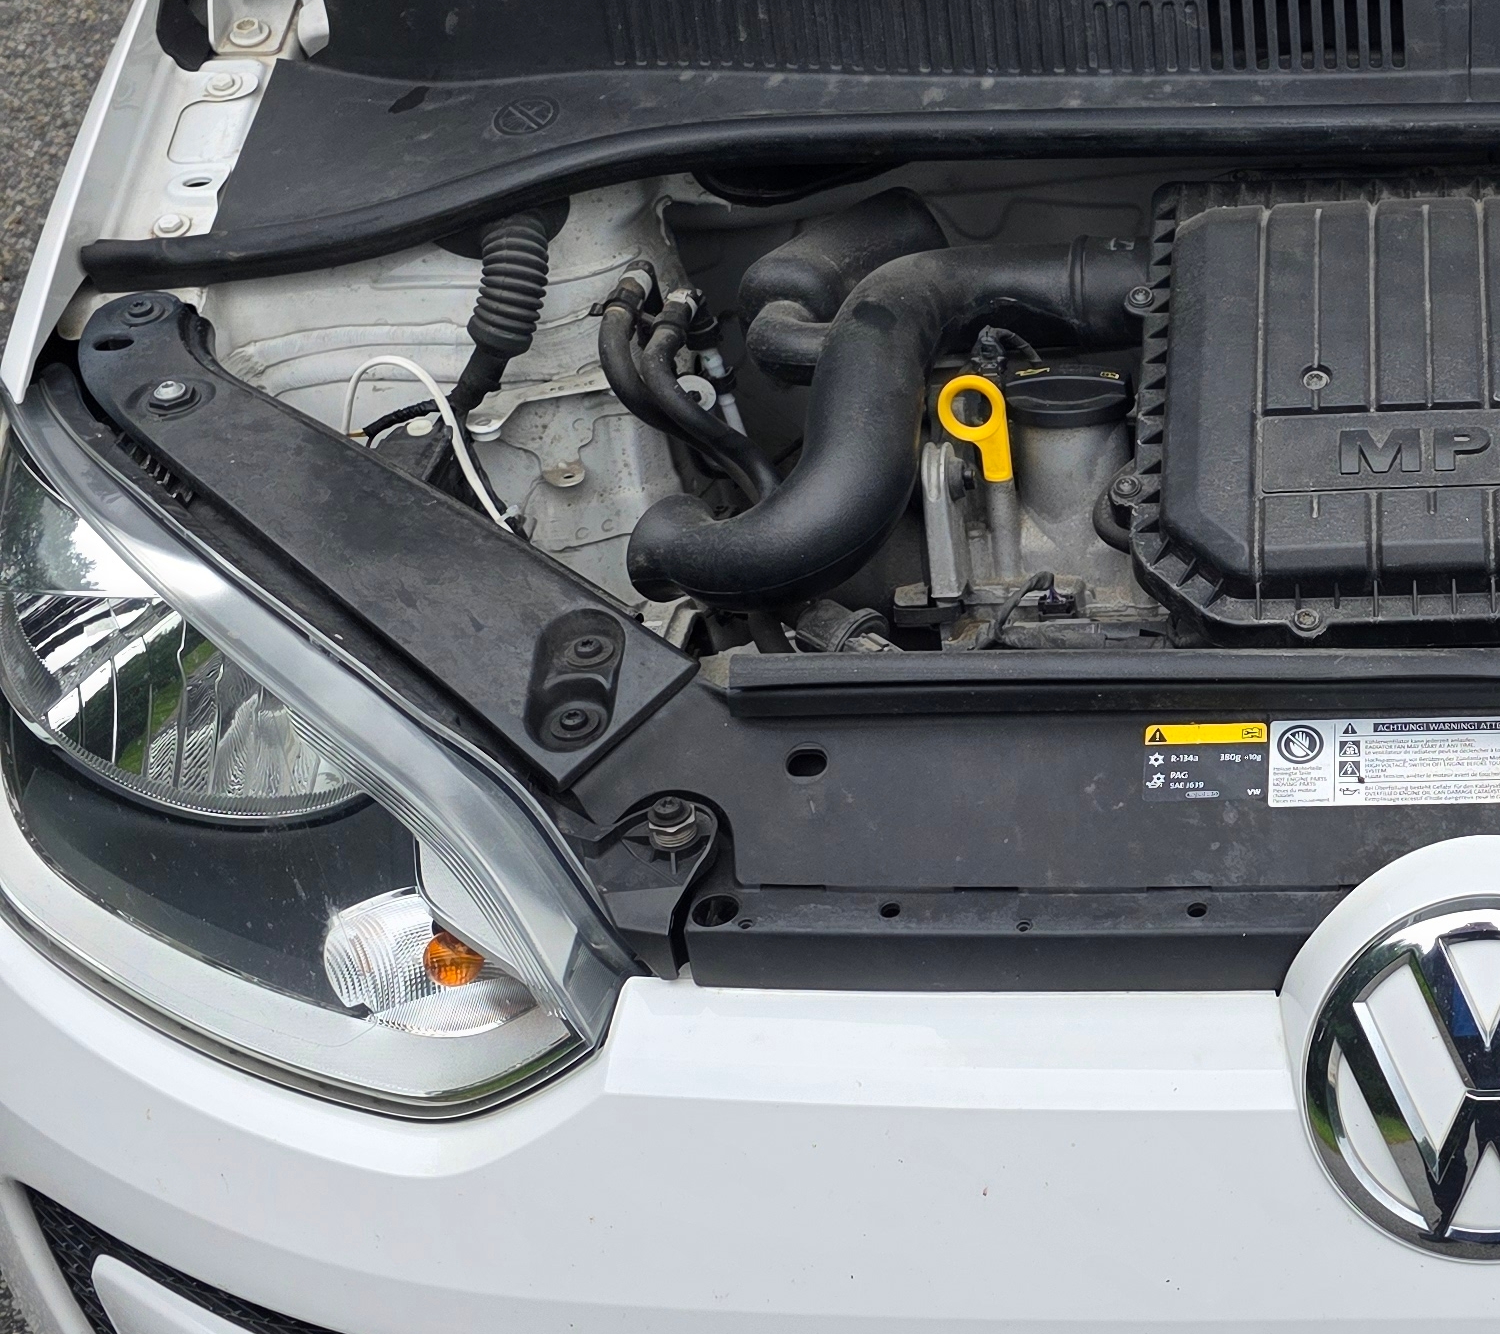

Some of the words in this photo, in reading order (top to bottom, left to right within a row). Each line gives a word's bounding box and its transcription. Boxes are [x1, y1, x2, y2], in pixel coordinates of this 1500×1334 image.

[1377, 723, 1427, 732] ACHTUNG!
[1429, 722, 1478, 731] WARNING!
[1170, 754, 1199, 762] R-134a
[1247, 788, 1262, 796] VW
